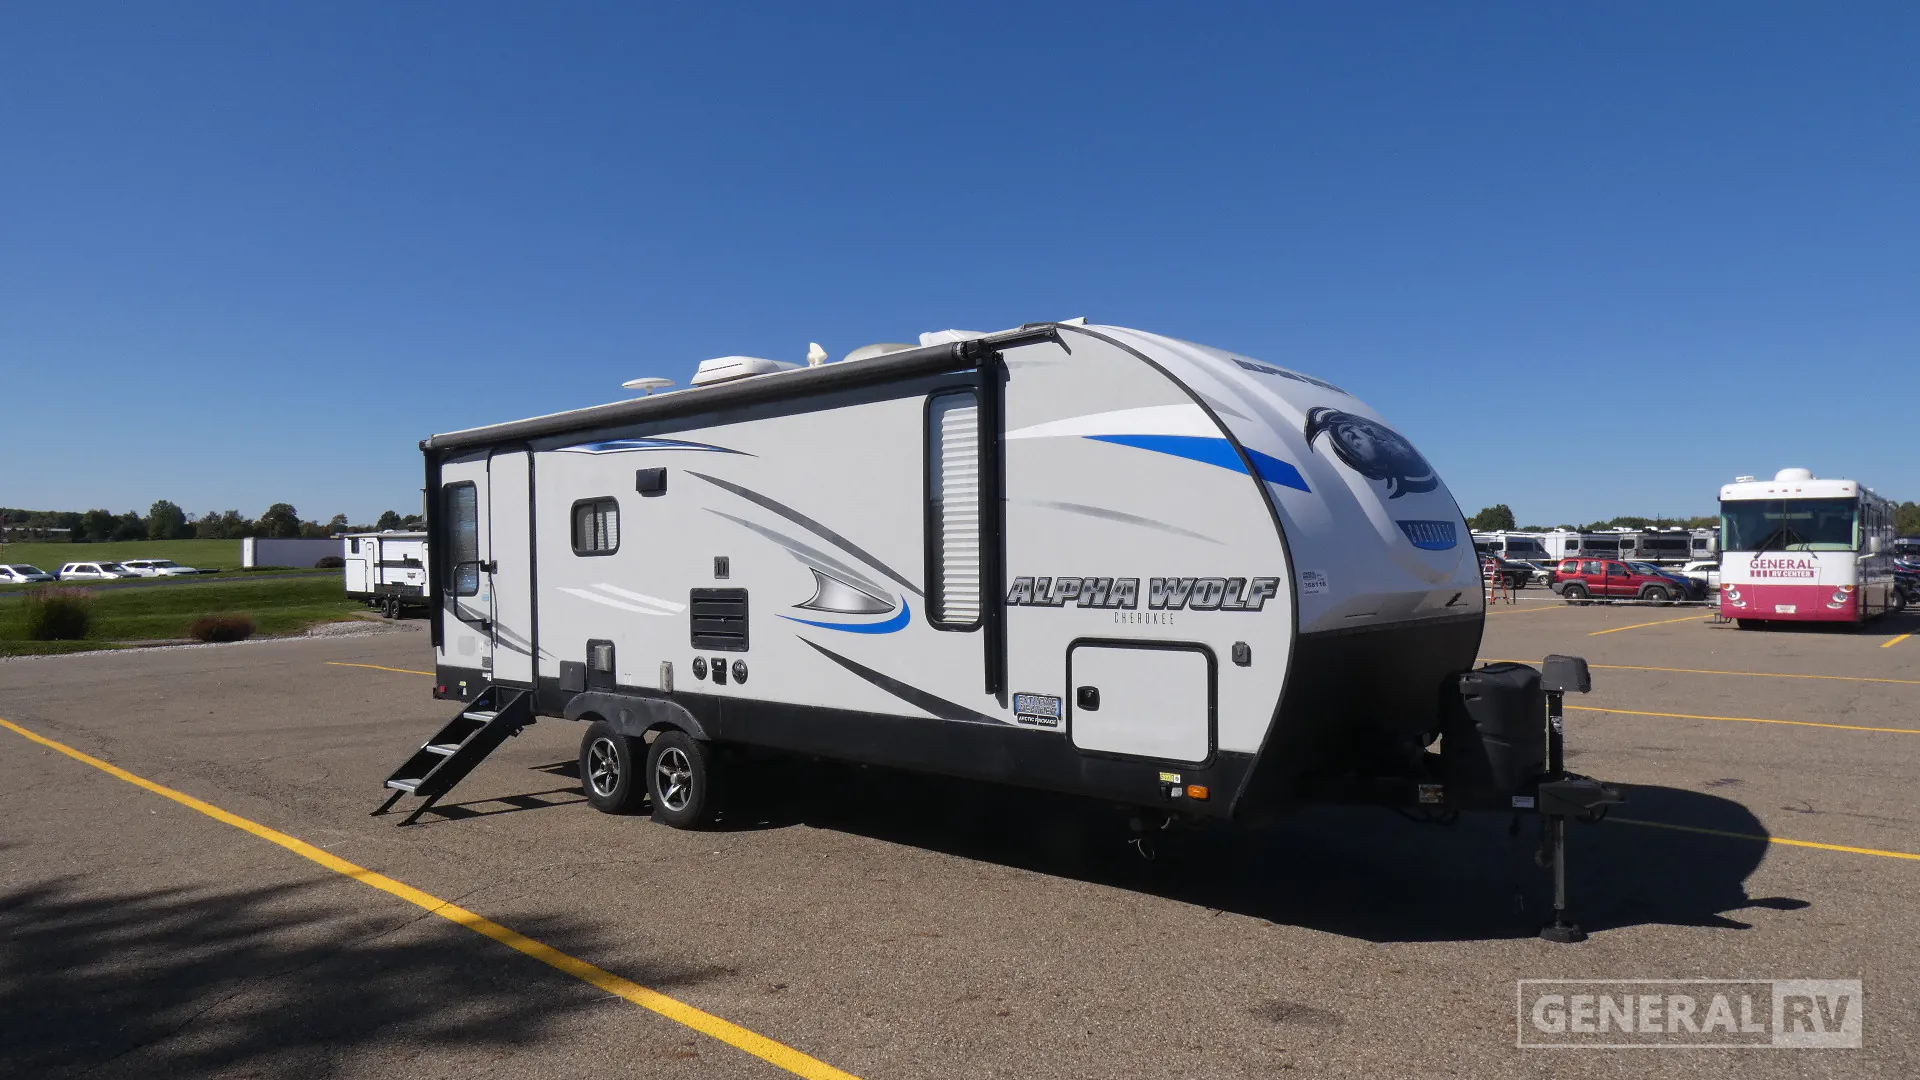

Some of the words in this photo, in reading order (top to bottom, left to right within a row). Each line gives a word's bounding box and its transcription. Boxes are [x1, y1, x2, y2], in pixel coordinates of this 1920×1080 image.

[1750, 559, 1814, 569] GENERAL
[1006, 576, 1140, 610] ALPHA
[1149, 577, 1281, 612] WOLF
[1114, 611, 1174, 625] CHEROKEE
